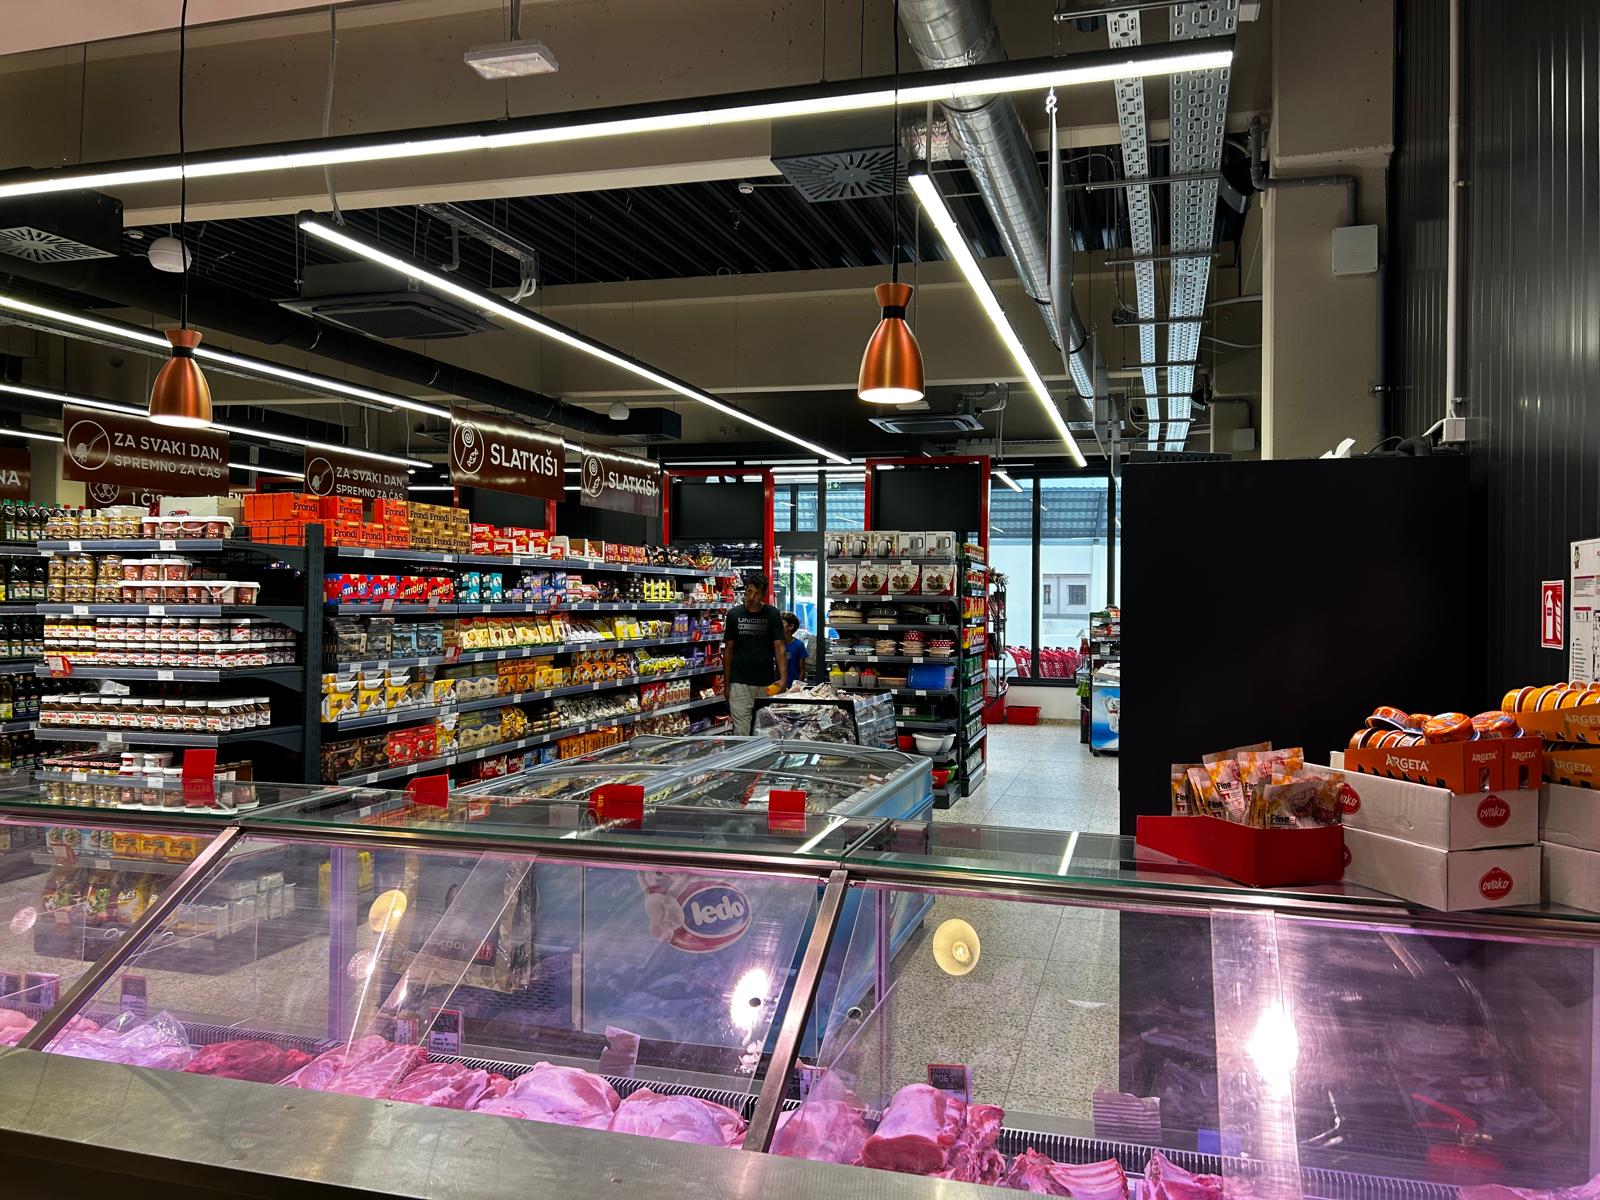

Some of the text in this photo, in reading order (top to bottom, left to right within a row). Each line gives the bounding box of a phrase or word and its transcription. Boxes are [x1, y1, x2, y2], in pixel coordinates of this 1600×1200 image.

[114, 432, 223, 464] ZA SVAKI DAN,
[490, 441, 558, 478] SLATKIŠI
[114, 455, 221, 479] SPREMNO ZA ČAS
[336, 466, 351, 479] ZA
[352, 469, 382, 484] SVAKI
[608, 470, 656, 497] SLATKIŠI
[336, 483, 376, 498] SPREMNO
[377, 490, 388, 500] ZA
[294, 502, 318, 513] Frondi
[339, 505, 361, 516] Frondi
[385, 507, 406, 518] Frondi
[410, 510, 429, 520] Frondi
[430, 512, 450, 522] Frondi
[334, 528, 358, 540] Frondi
[361, 530, 383, 541] Frondi
[387, 532, 409, 543] Frondi
[411, 535, 432, 545] Frondi
[1471, 752, 1497, 763] ARGETA
[1511, 750, 1536, 761] ARGETA
[1385, 753, 1428, 772] ARGETA
[1553, 757, 1593, 774] ARGETA
[1479, 803, 1506, 819] ovako
[1482, 877, 1511, 891] ovako
[690, 895, 745, 926] ledo
